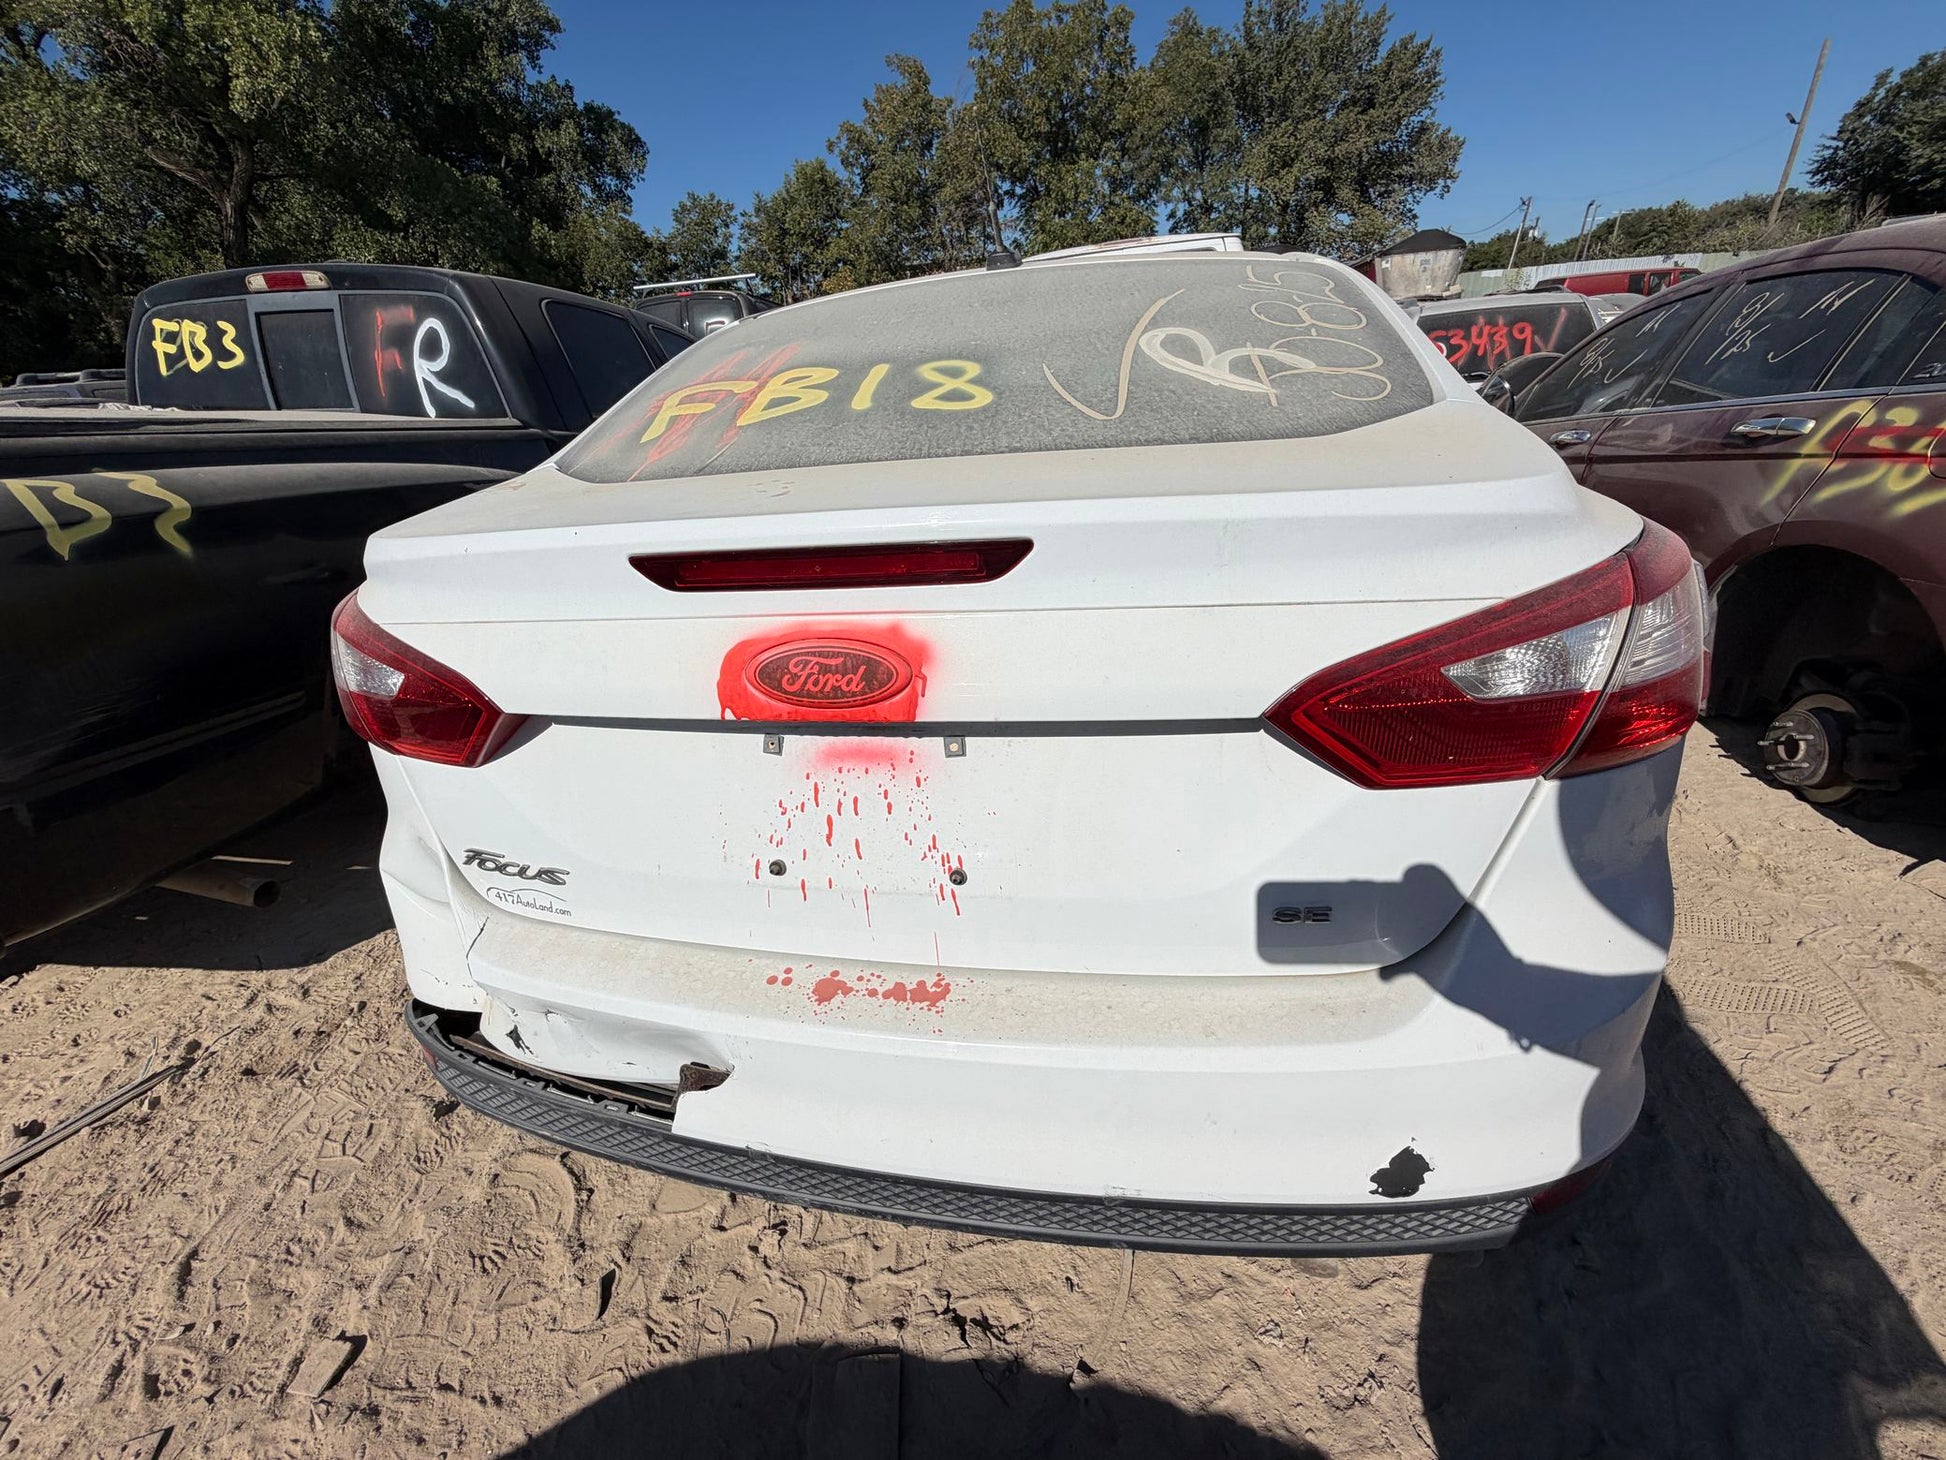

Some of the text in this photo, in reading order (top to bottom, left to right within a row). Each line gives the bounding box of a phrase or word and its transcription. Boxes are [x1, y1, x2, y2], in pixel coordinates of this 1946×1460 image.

[151, 318, 246, 377] FB3
[413, 317, 476, 419] R
[639, 359, 995, 443] FB18
[781, 656, 867, 694] Ford
[494, 891, 573, 917] 417AutoLand.com
[1271, 906, 1333, 925] SE
